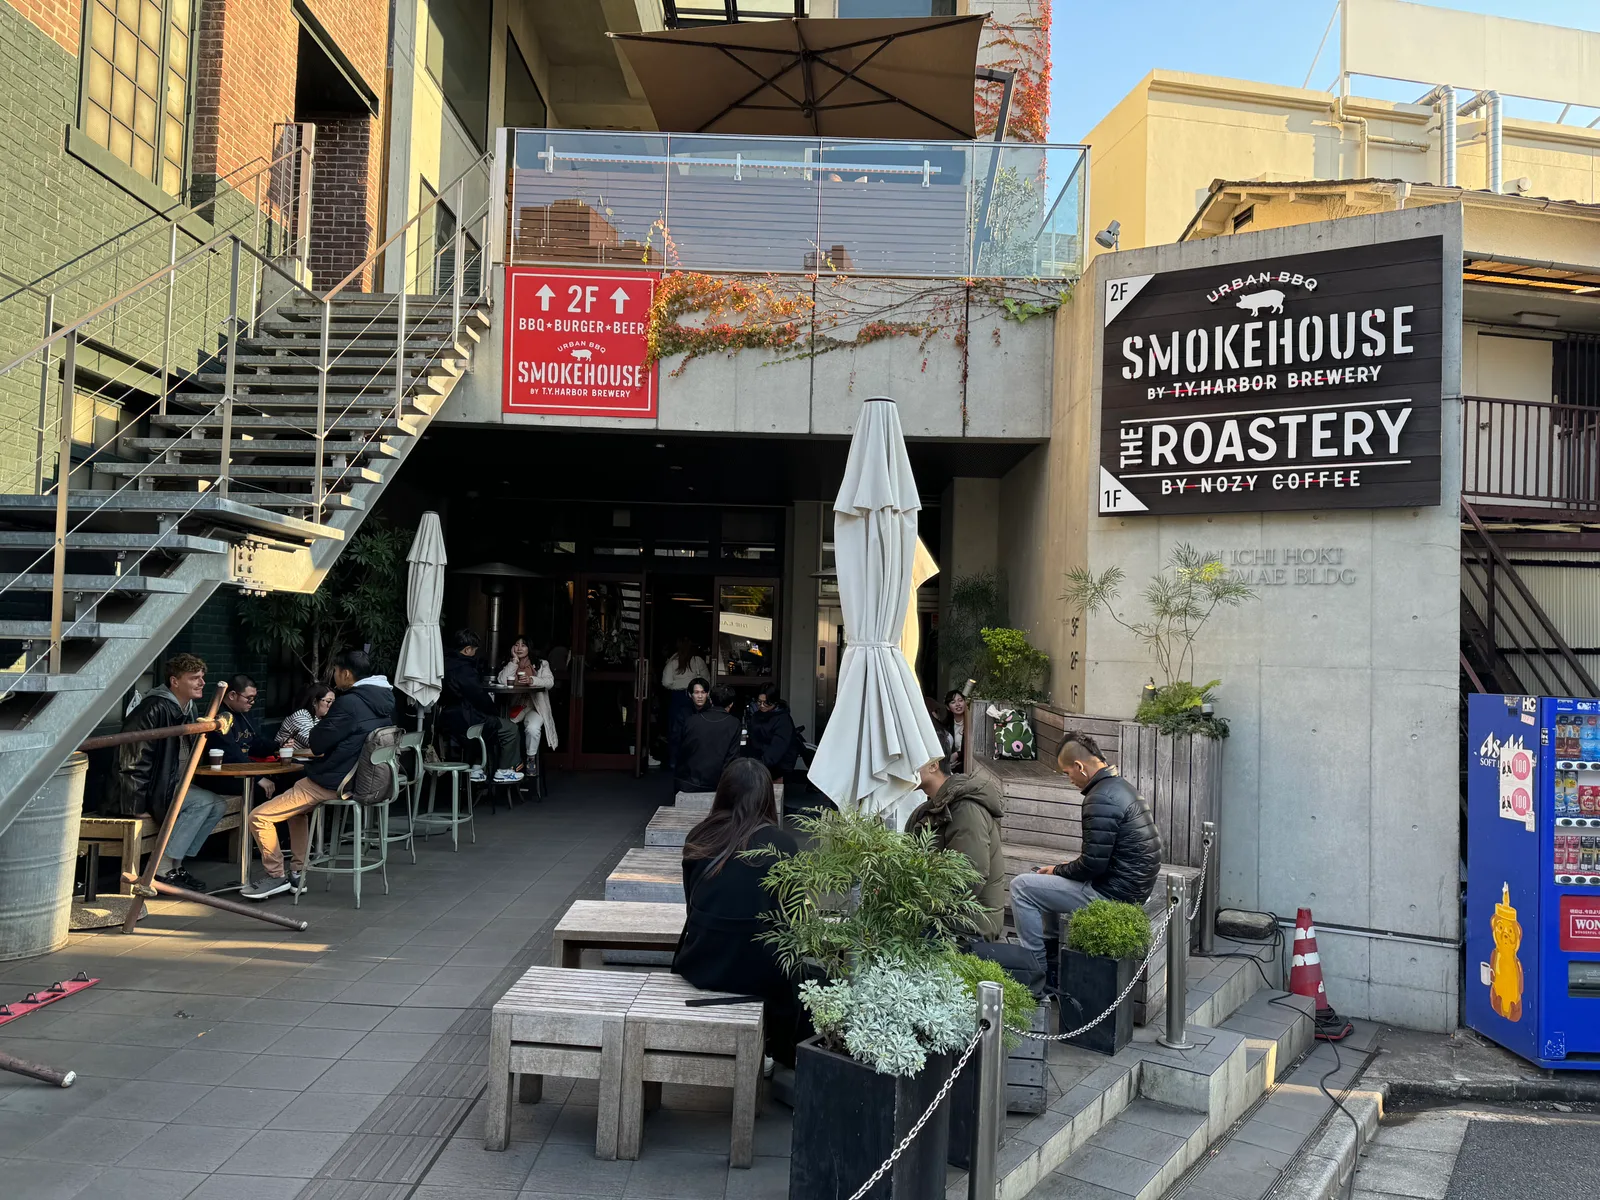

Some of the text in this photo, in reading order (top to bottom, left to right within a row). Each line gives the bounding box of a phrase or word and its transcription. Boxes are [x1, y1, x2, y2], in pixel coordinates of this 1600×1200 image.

[1110, 282, 1129, 301] 2F
[1206, 271, 1318, 303] URBAN BBQ
[567, 285, 599, 313] 2F
[519, 317, 645, 335] BBQ BURGER BEER
[557, 340, 606, 354] URBAN BBQ
[1121, 305, 1414, 380] SMOKEHOUSE
[518, 361, 642, 387] SMOKEHOUSE
[1147, 386, 1165, 400] BY
[1287, 365, 1382, 388] BREWERY
[591, 389, 631, 398] BREWERY
[1151, 407, 1412, 466] ROASTERY
[1120, 426, 1143, 469] THE
[1161, 470, 1360, 495] BY NOZY COFFEE
[1104, 489, 1122, 508] 1F
[1230, 549, 1275, 566] ICHI
[1284, 548, 1344, 566] HOKI
[1294, 568, 1356, 586] BLDG
[1070, 651, 1079, 670] 2F
[1070, 684, 1078, 704] 1F
[1480, 757, 1497, 767] SOFT
